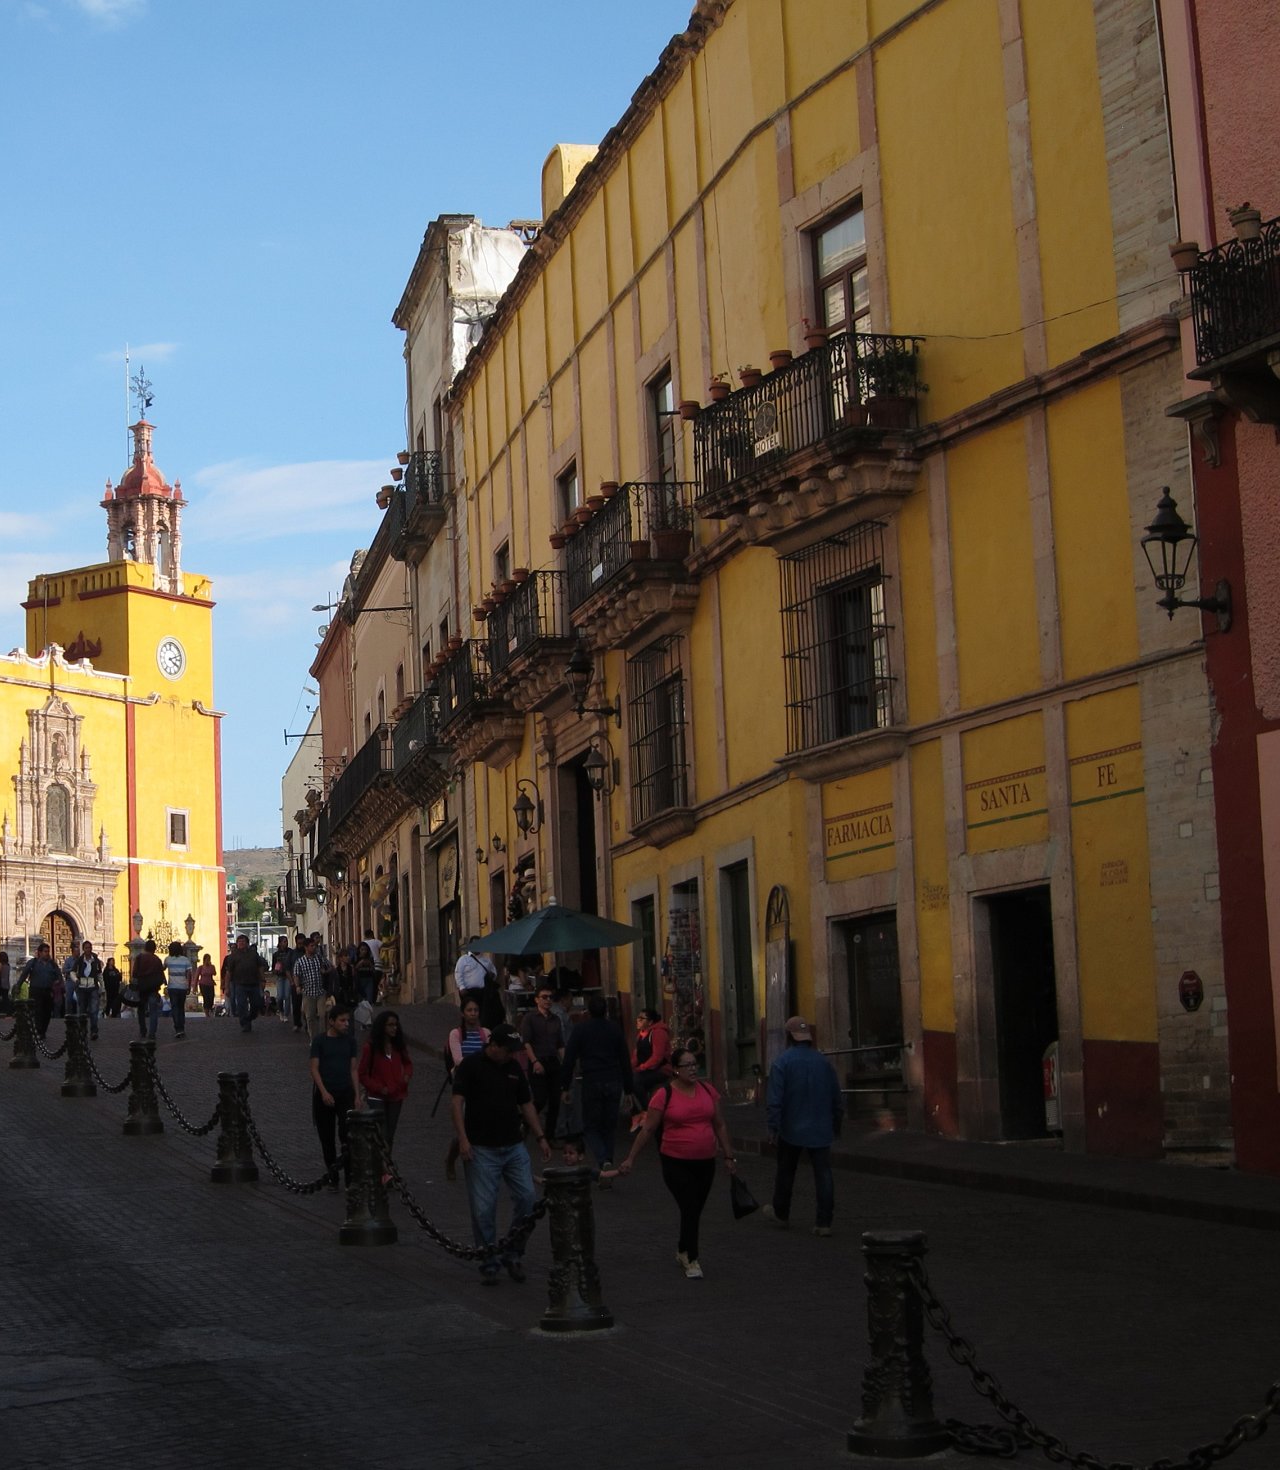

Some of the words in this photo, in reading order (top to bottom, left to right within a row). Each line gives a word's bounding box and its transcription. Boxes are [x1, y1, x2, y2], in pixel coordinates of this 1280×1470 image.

[826, 816, 892, 847] FARMACIA
[981, 783, 1031, 812] SANTA
[1098, 764, 1117, 788] FE
